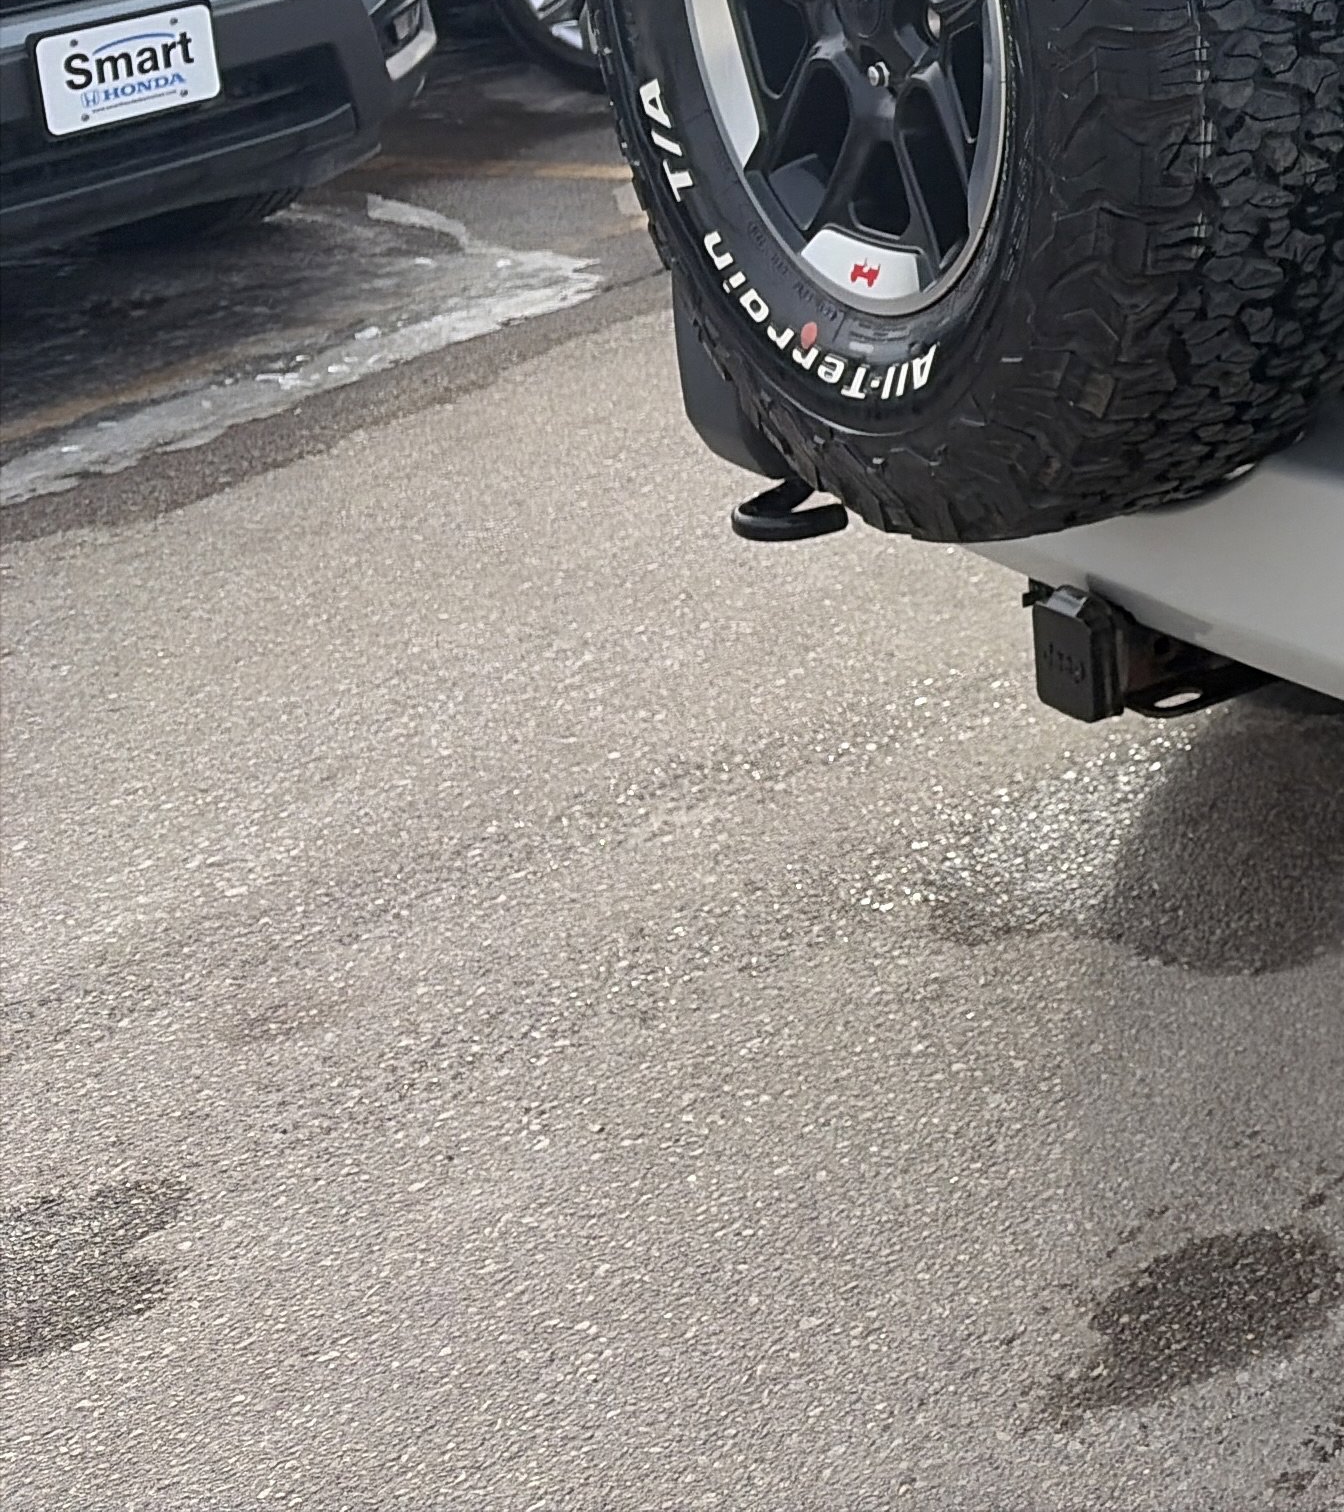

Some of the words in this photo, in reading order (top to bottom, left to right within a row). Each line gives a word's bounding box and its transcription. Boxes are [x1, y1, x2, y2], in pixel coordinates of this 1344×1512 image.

[63, 31, 195, 91] Smart
[103, 72, 187, 102] HONDA
[639, 77, 695, 203] T/A
[702, 230, 941, 400] All-Terrain
